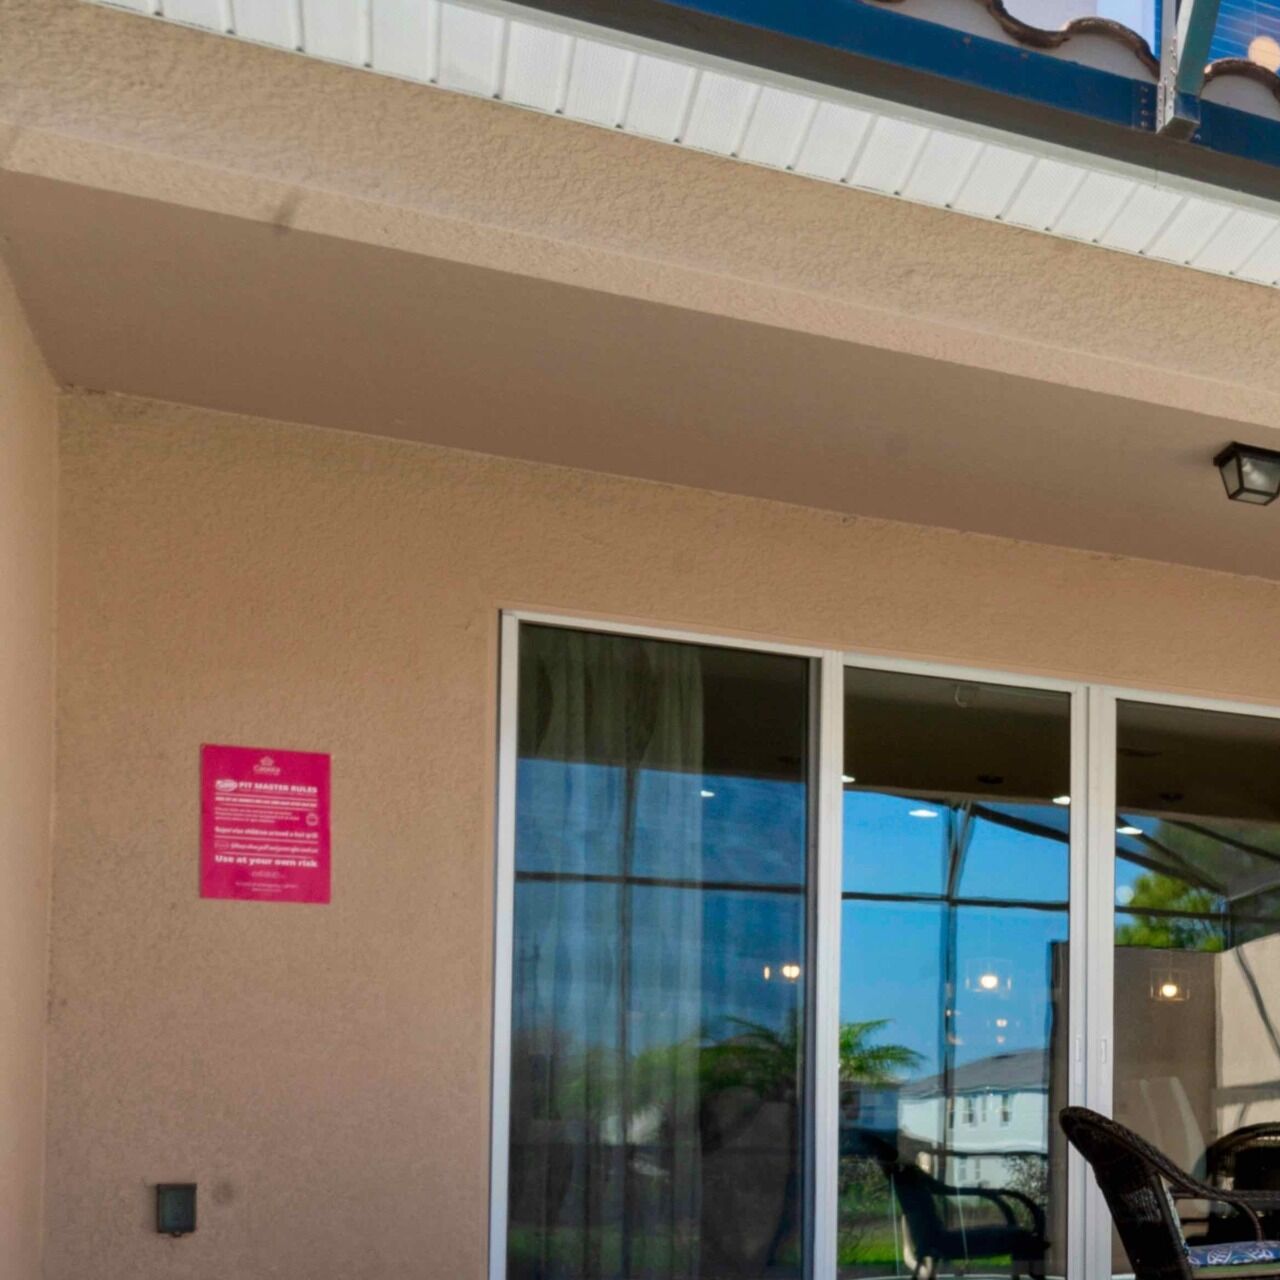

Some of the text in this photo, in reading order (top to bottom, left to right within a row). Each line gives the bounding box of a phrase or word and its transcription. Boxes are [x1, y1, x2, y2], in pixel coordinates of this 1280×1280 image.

[215, 854, 318, 868] Use at your own risk
